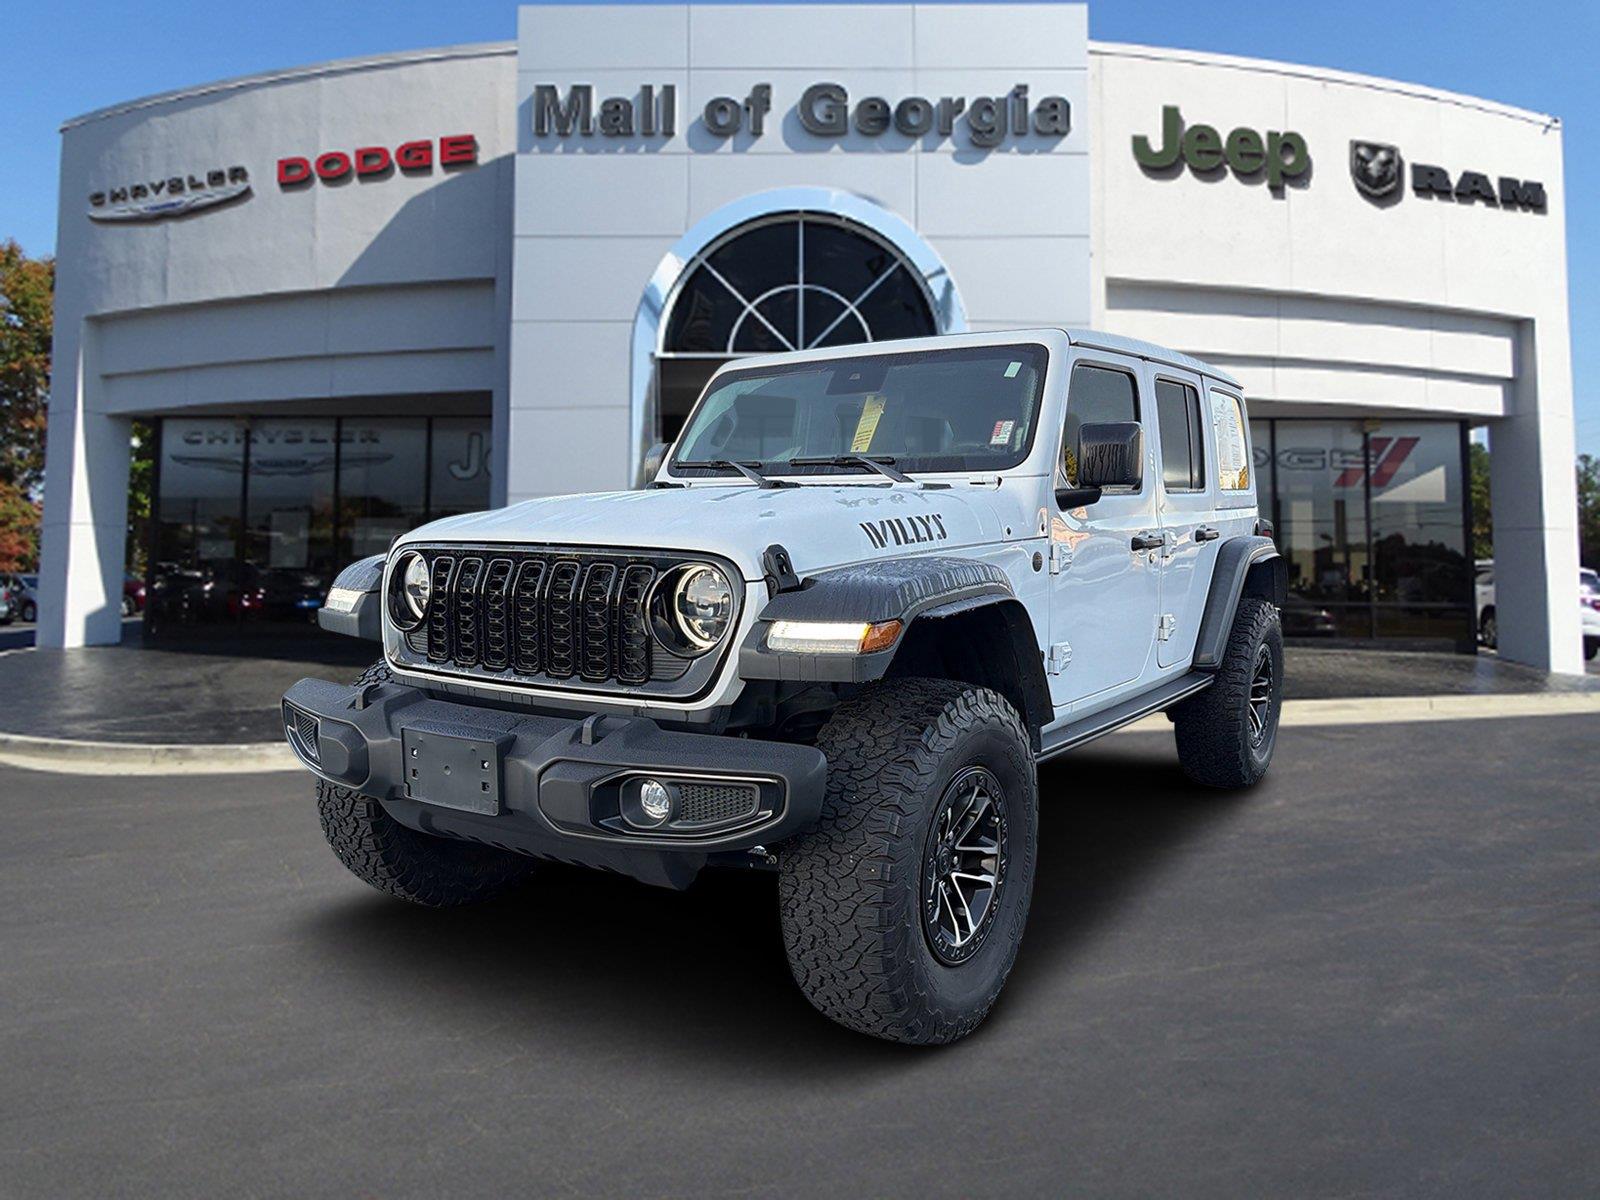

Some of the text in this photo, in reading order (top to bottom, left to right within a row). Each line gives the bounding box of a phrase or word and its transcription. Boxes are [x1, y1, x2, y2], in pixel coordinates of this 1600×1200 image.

[532, 83, 1073, 148] Mall of Georgia
[277, 134, 477, 187] DODGE
[1132, 105, 1311, 192] Jeep
[89, 166, 249, 206] CHRYSLER
[1411, 163, 1547, 212] RAM
[183, 430, 381, 444] CHRYSLER
[859, 514, 947, 549] WILLYS
